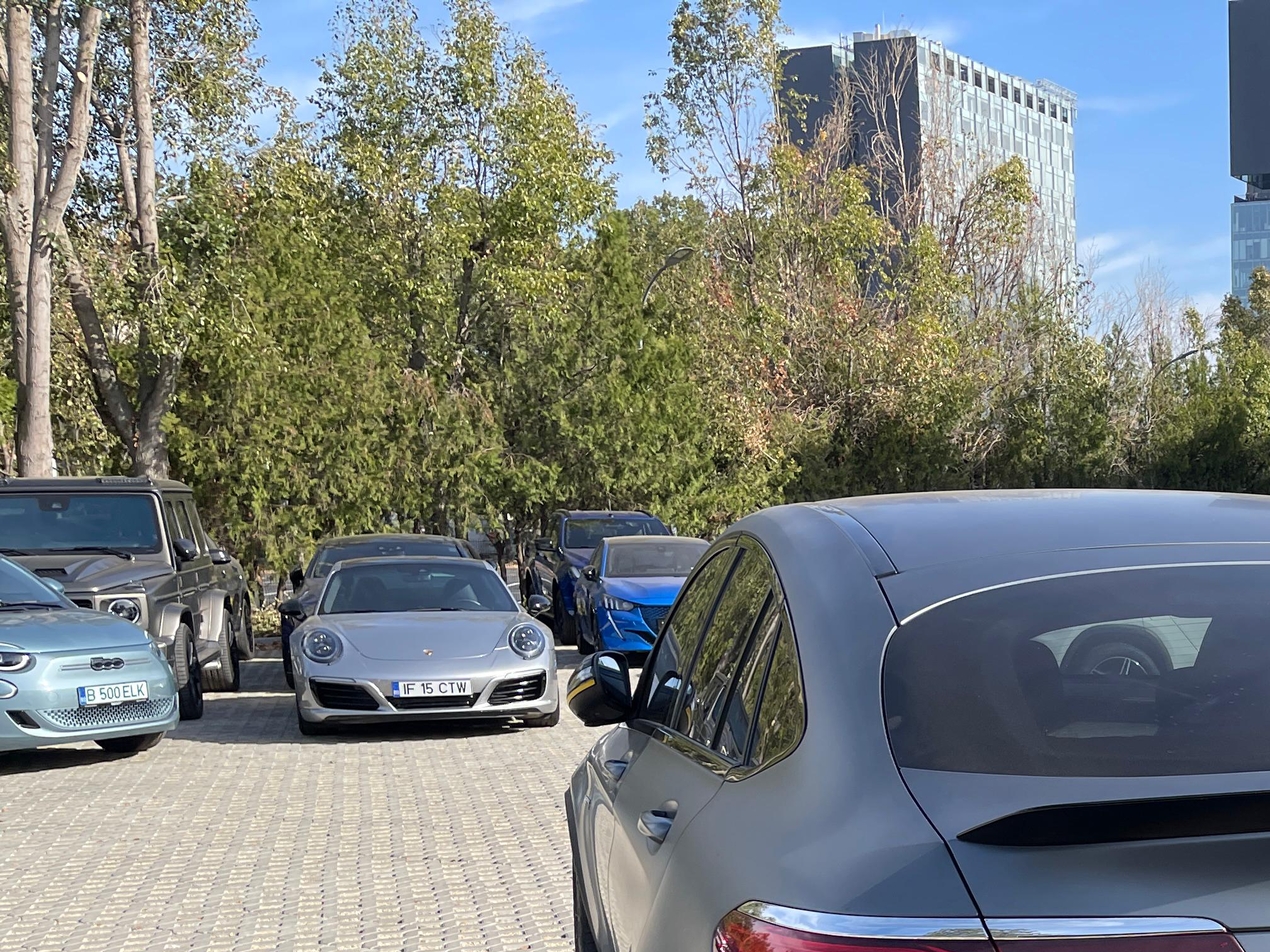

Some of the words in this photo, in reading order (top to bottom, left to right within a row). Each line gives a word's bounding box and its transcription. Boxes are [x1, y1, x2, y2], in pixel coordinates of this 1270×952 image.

[87, 688, 96, 702] B
[100, 686, 120, 700] 500
[123, 684, 146, 699] ELK
[403, 682, 415, 695] IF
[421, 682, 434, 695] 15
[438, 681, 467, 694] CTW
